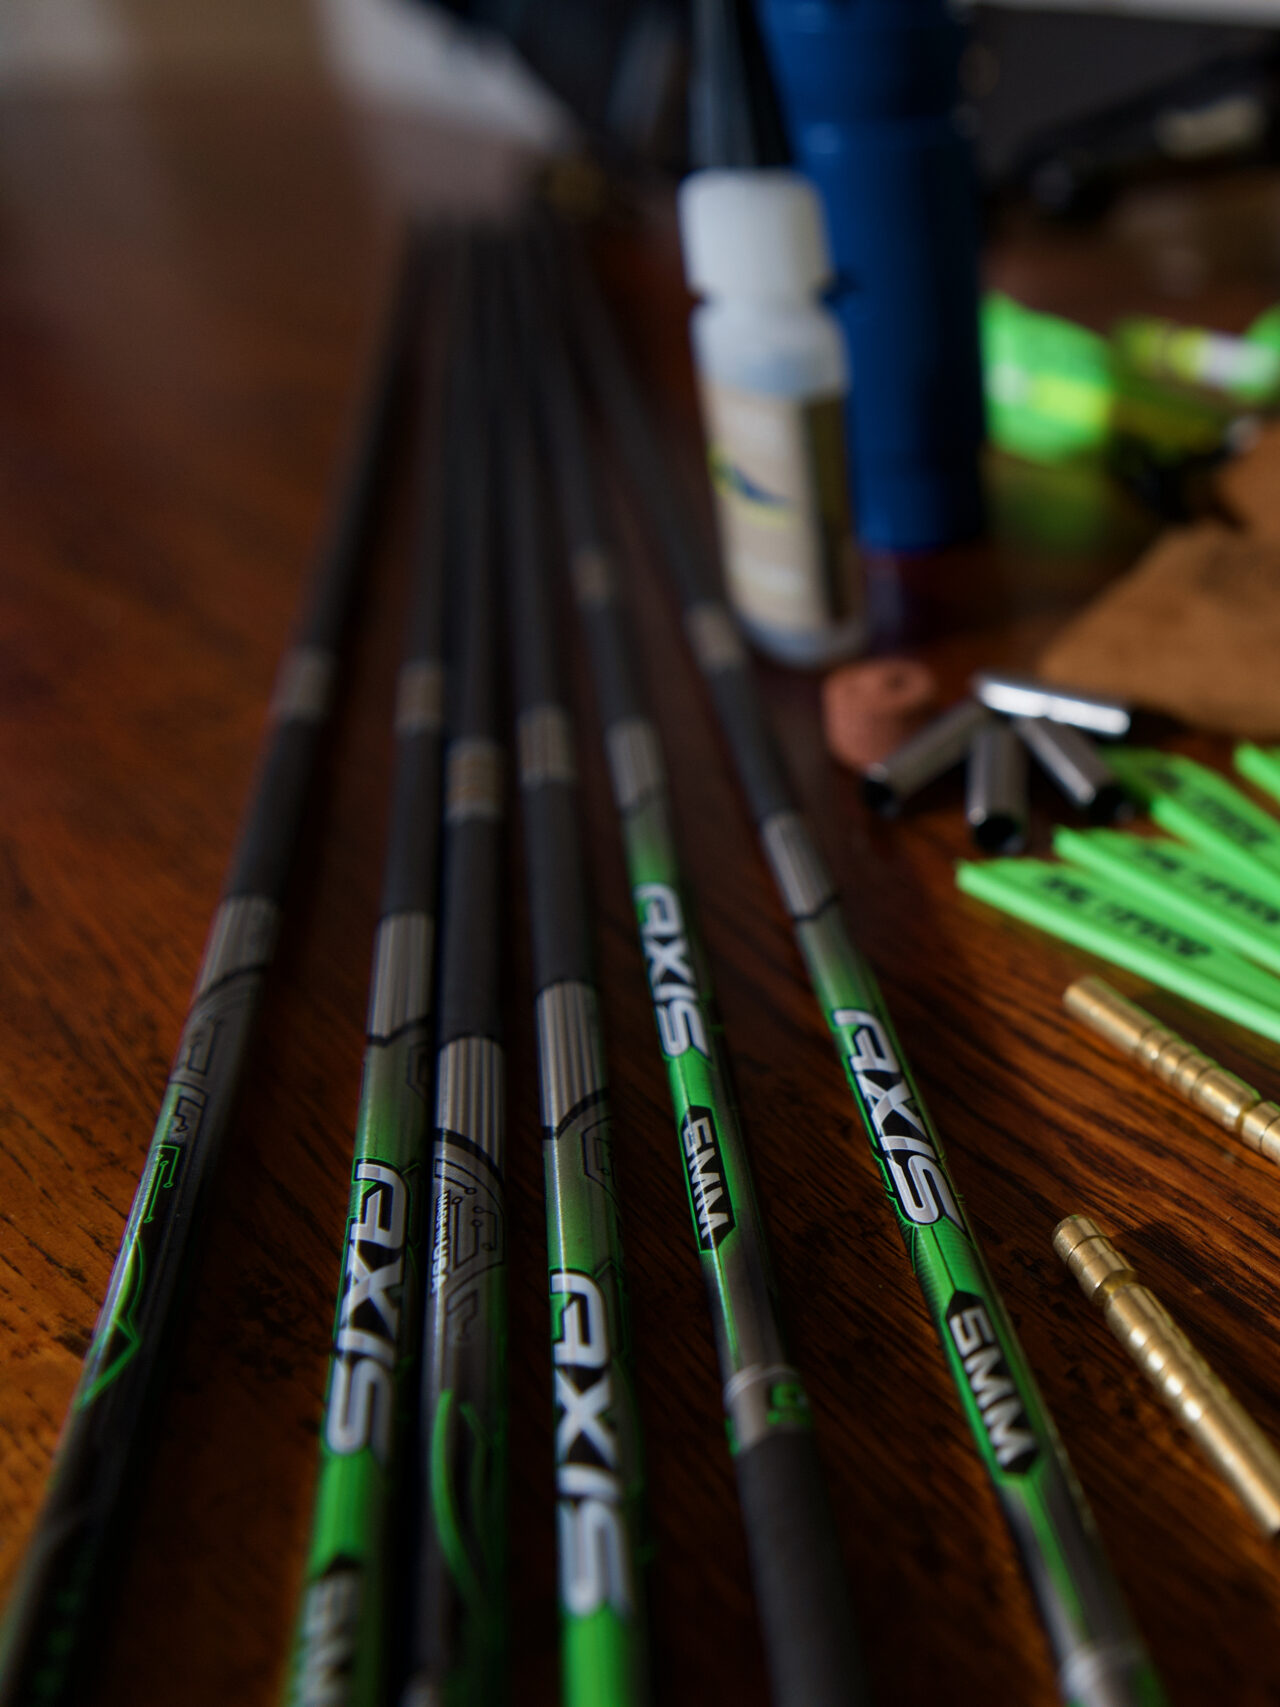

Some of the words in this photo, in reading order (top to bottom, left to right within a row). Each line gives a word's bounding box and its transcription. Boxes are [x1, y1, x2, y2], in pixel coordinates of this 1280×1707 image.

[635, 883, 711, 1059] AXIS
[683, 1115, 728, 1249] 5MM
[834, 1009, 966, 1233] AXIS
[326, 1163, 407, 1465] AXIS
[431, 1241, 449, 1294] USA
[551, 1271, 632, 1620] AXIS
[950, 1306, 1036, 1467] 5MM
